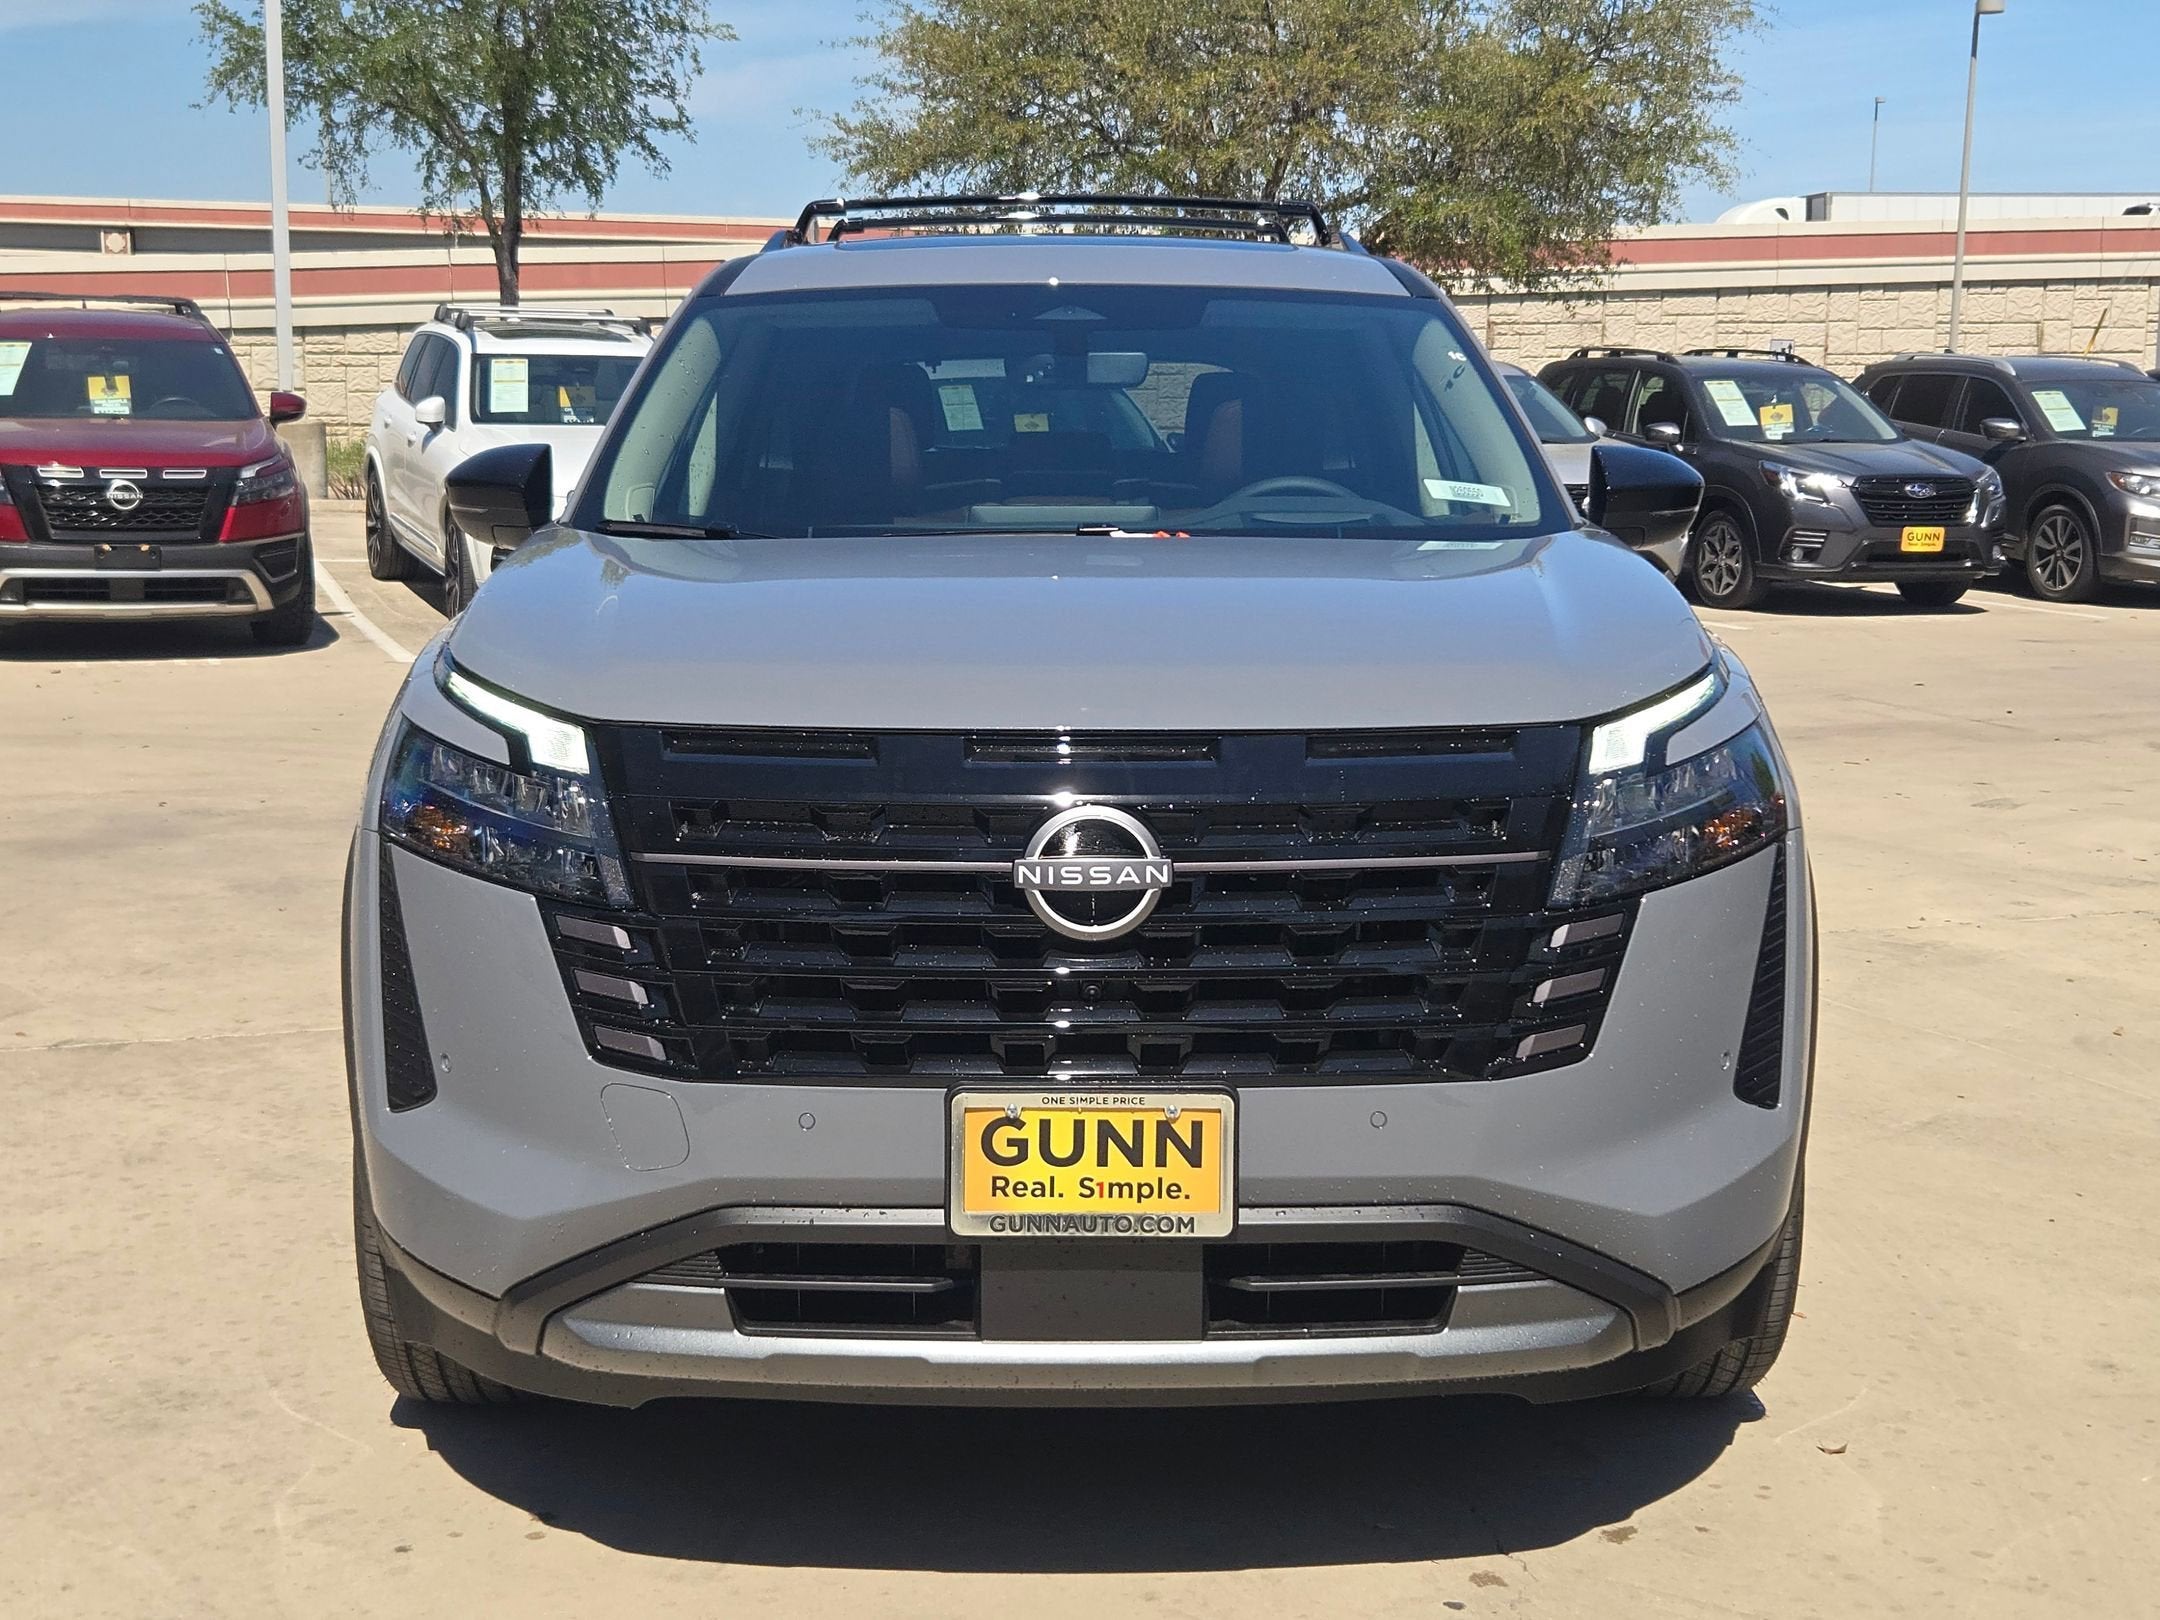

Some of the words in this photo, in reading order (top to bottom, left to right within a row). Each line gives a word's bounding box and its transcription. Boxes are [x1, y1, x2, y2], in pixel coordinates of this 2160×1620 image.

[1907, 532, 1941, 541] GUNN
[1018, 865, 1168, 885] NISSAN
[1041, 1096, 1066, 1105] ONE
[1069, 1096, 1109, 1105] SIMPLE
[1112, 1096, 1146, 1106] PRICE
[980, 1116, 1203, 1169] GUNN
[991, 1175, 1064, 1199] Real.
[989, 1214, 1196, 1234] GUNNAUTO.COM
